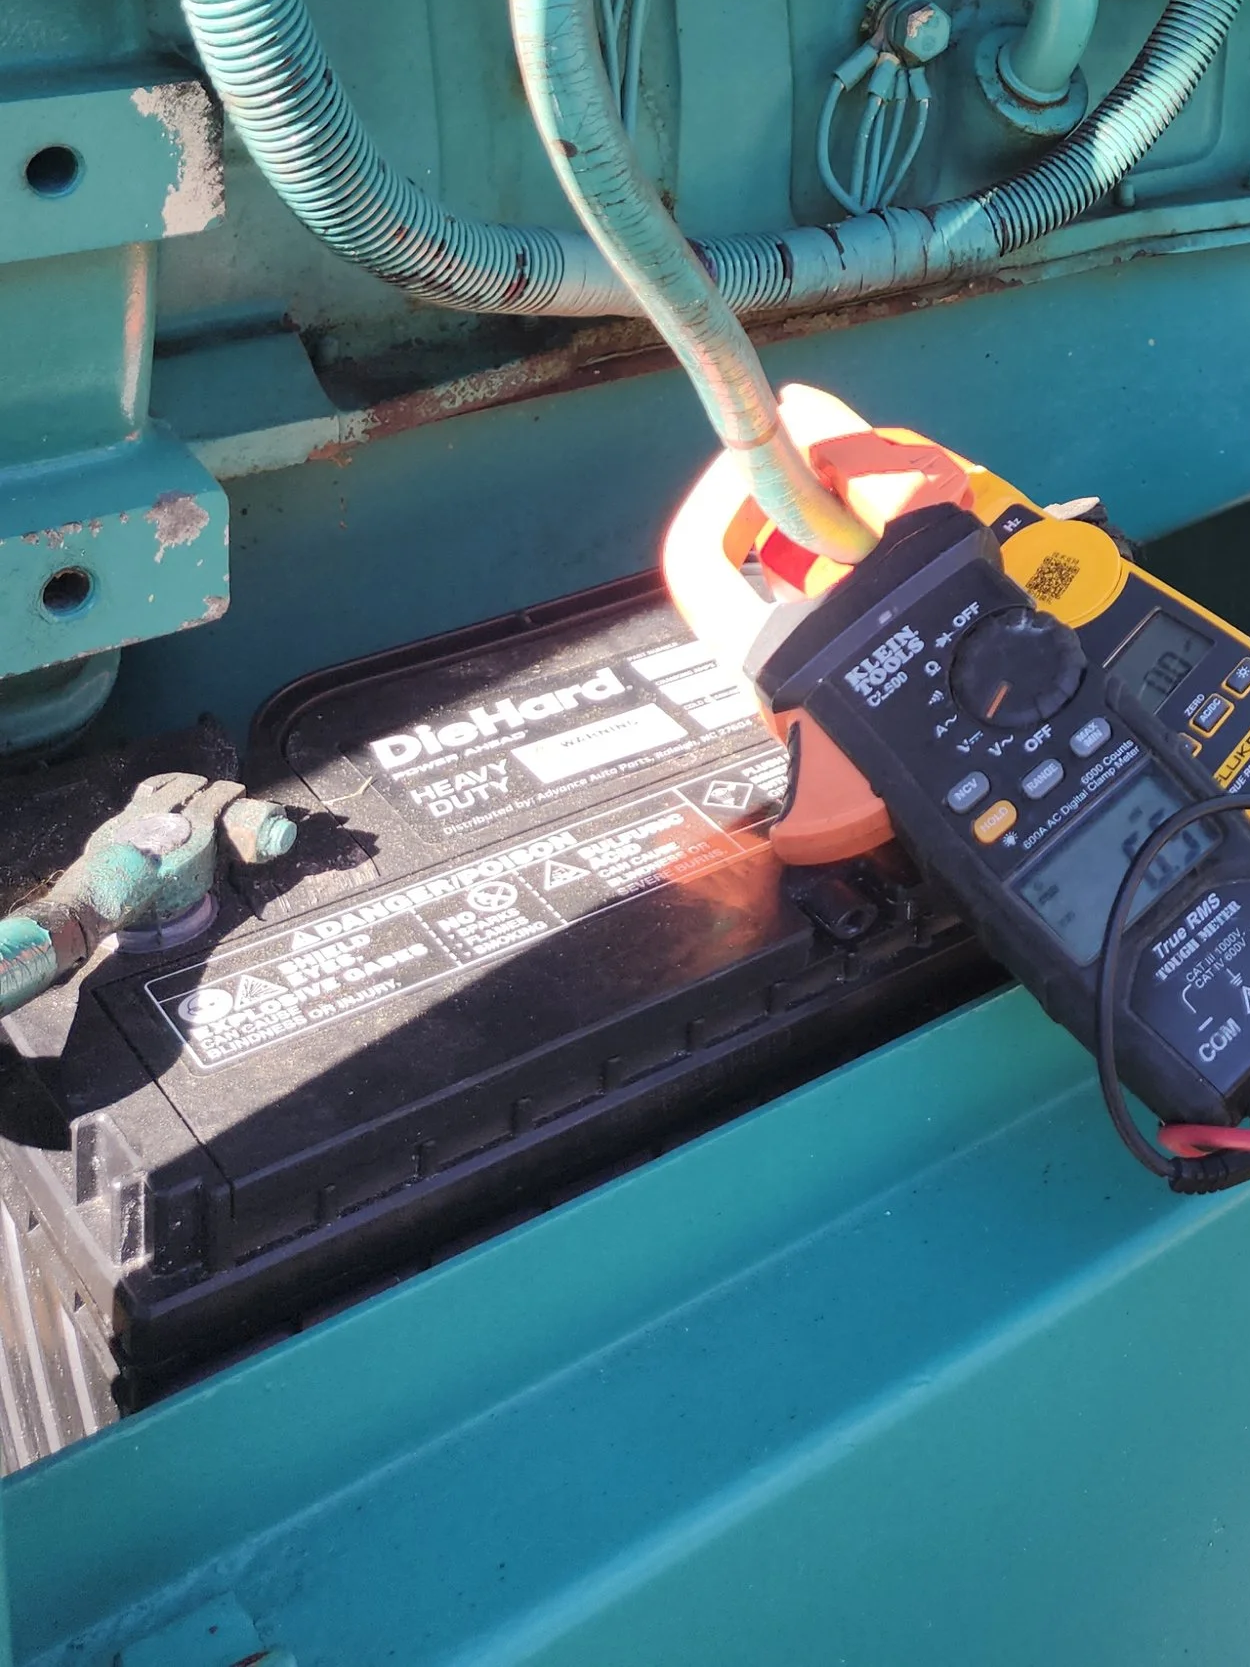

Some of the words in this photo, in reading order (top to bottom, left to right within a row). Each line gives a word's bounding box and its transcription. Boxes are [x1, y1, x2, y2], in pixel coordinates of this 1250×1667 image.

[1003, 517, 1022, 532] Hz
[953, 601, 980, 627] OFF
[844, 625, 917, 687] KLEIN
[854, 637, 925, 696] TOOLS
[370, 669, 625, 771] DieHard
[1184, 694, 1205, 716] ZERO
[1199, 698, 1221, 723] AC/DC
[1024, 723, 1052, 752] OFF
[1076, 722, 1098, 742] MAX
[1083, 729, 1103, 747] MIN
[392, 754, 459, 781] POWER
[410, 759, 507, 805] HEAVY
[443, 804, 513, 835] Distributed
[537, 779, 587, 802] Advance
[588, 767, 617, 783] Auto
[619, 756, 655, 772] Parts,
[655, 739, 700, 760] Raleigh,
[700, 731, 718, 743] NC
[1026, 763, 1058, 791] RANGE
[1080, 763, 1103, 785] 6000
[1102, 739, 1134, 766] Counts
[1228, 775, 1246, 793] RUE
[429, 776, 509, 819] DUTY
[953, 778, 977, 800] NCV
[1023, 826, 1048, 850] 600A
[1047, 813, 1062, 829] AC
[1060, 790, 1089, 816] Digital
[1087, 767, 1116, 792] Clamp
[1114, 746, 1140, 769] Meter
[980, 807, 1008, 832] HOLD
[589, 843, 642, 870] ACID
[607, 850, 685, 888] BLINDNESS
[688, 841, 711, 855] OR
[617, 867, 672, 896] SEVERE
[675, 848, 728, 873] BURNS.
[312, 831, 578, 942] DANGER/POISON
[437, 910, 476, 932] NO
[1151, 926, 1188, 960] True
[1185, 892, 1222, 931] RMS
[1155, 939, 1200, 981] TOUGH
[1199, 900, 1242, 943] METER
[278, 933, 371, 975] SHIELD
[1185, 959, 1207, 984] CAT
[1204, 952, 1216, 968] III
[1194, 964, 1216, 989] CAT
[1213, 960, 1226, 976] IV
[1225, 938, 1247, 962] 600V
[190, 977, 342, 1039] EXPLOSIVE
[343, 943, 429, 982] GASES
[201, 1030, 241, 1051] CAN
[239, 1005, 302, 1037] CAUSE
[206, 1013, 308, 1060] BLINDNESS
[307, 1002, 337, 1021] OR
[1198, 1017, 1242, 1062] COM
